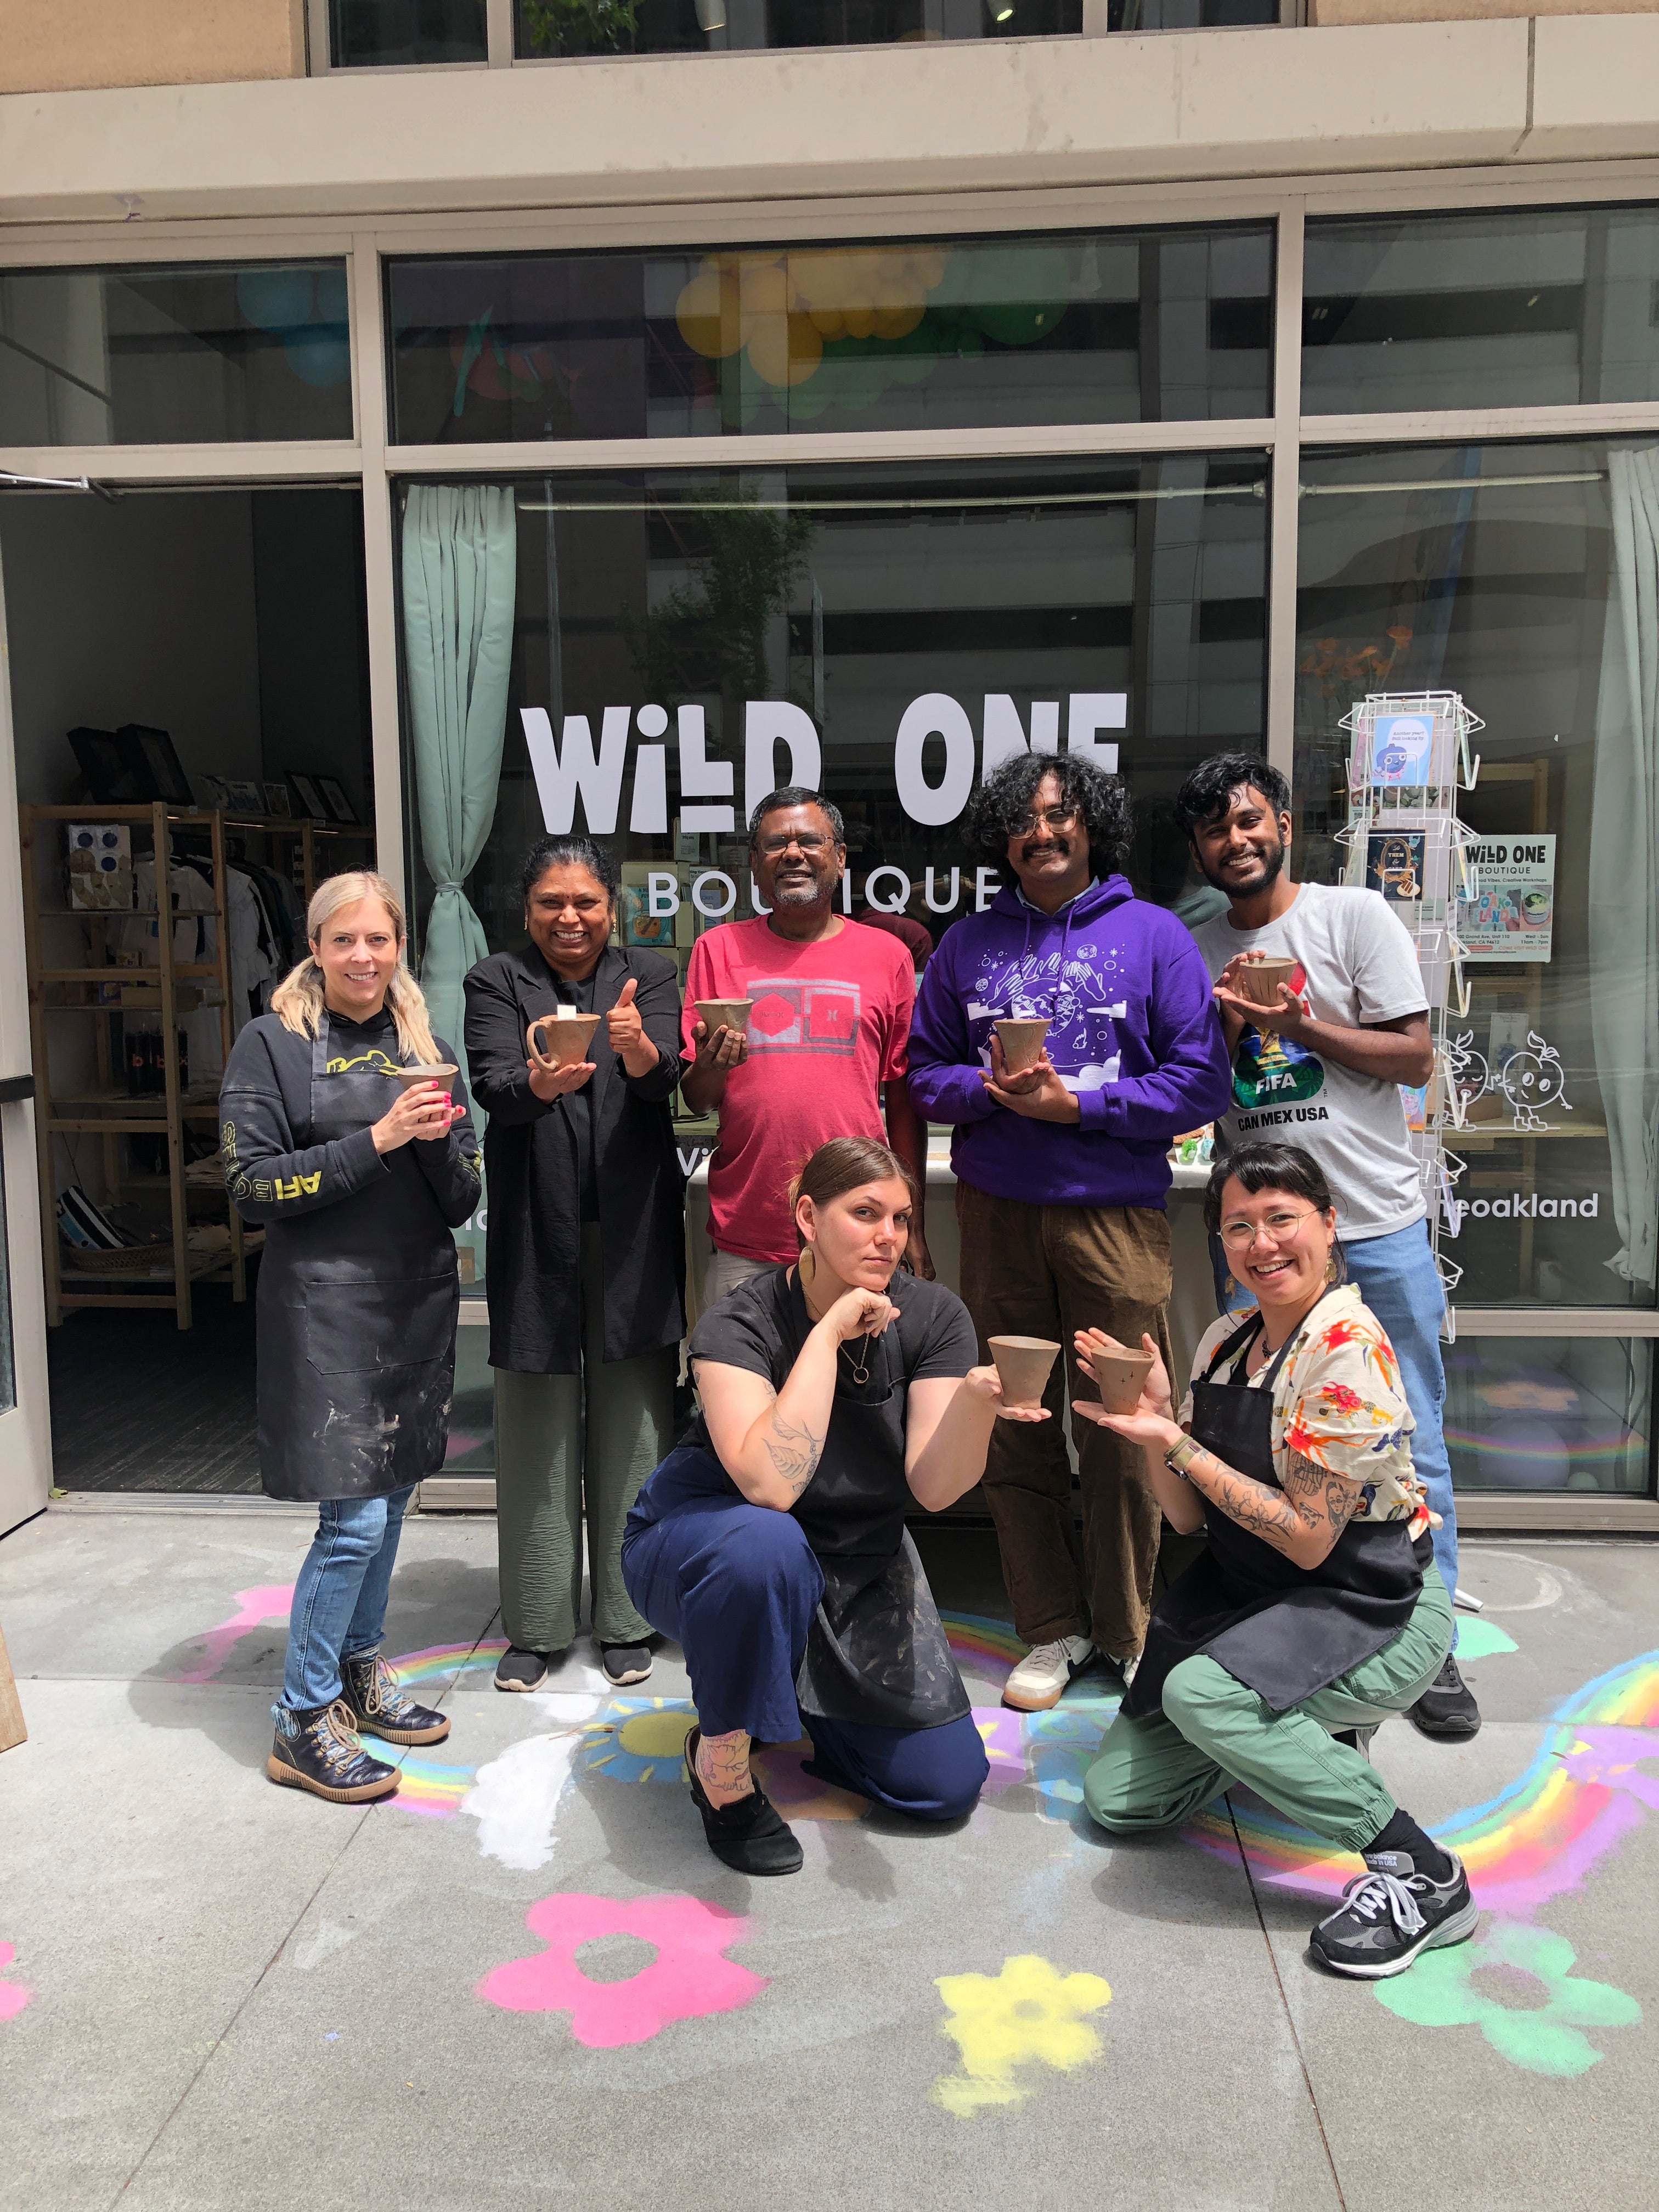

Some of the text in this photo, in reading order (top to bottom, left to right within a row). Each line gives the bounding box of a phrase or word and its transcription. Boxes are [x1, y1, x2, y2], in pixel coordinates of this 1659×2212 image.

[1513, 845, 1546, 863] ONE
[648, 866, 1002, 917] BOIQUE
[1255, 1073, 1297, 1095] FIFA
[1238, 1107, 1329, 1132] CAN MEX USA
[275, 1170, 322, 1200] AFI
